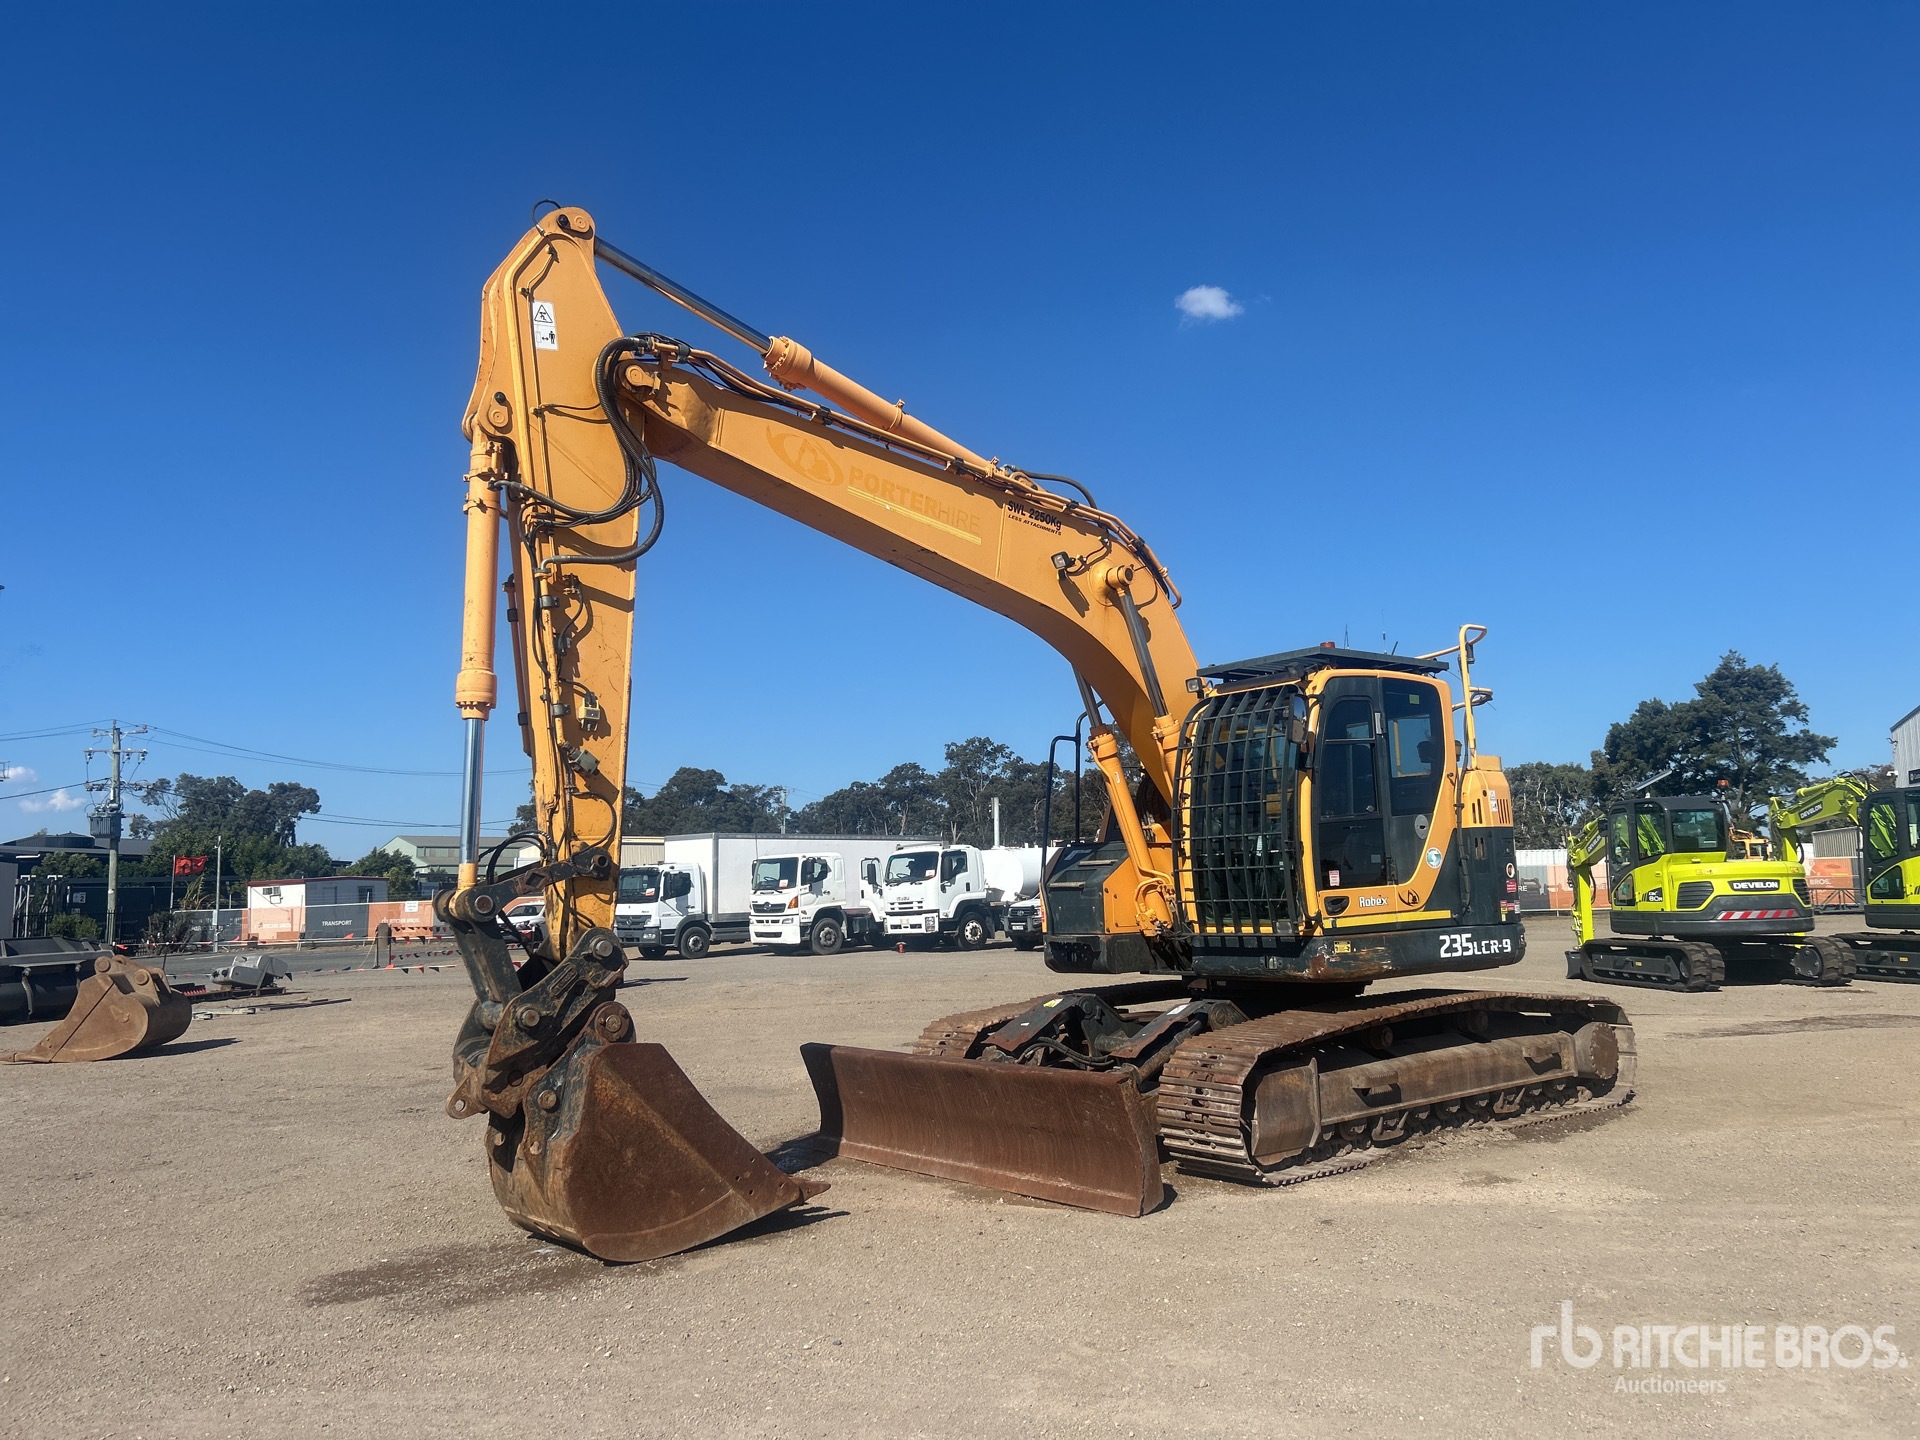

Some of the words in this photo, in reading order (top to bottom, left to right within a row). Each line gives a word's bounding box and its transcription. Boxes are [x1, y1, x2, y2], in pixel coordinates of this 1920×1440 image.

[1007, 500, 1026, 517] SWL
[1029, 508, 1062, 531] 2250Kg
[1008, 514, 1022, 522] LESS
[1023, 519, 1062, 536] ATTACHMENTS
[1732, 881, 1779, 890] DEVELON
[1359, 896, 1388, 908] Robex
[321, 919, 353, 927] TRANSPORT
